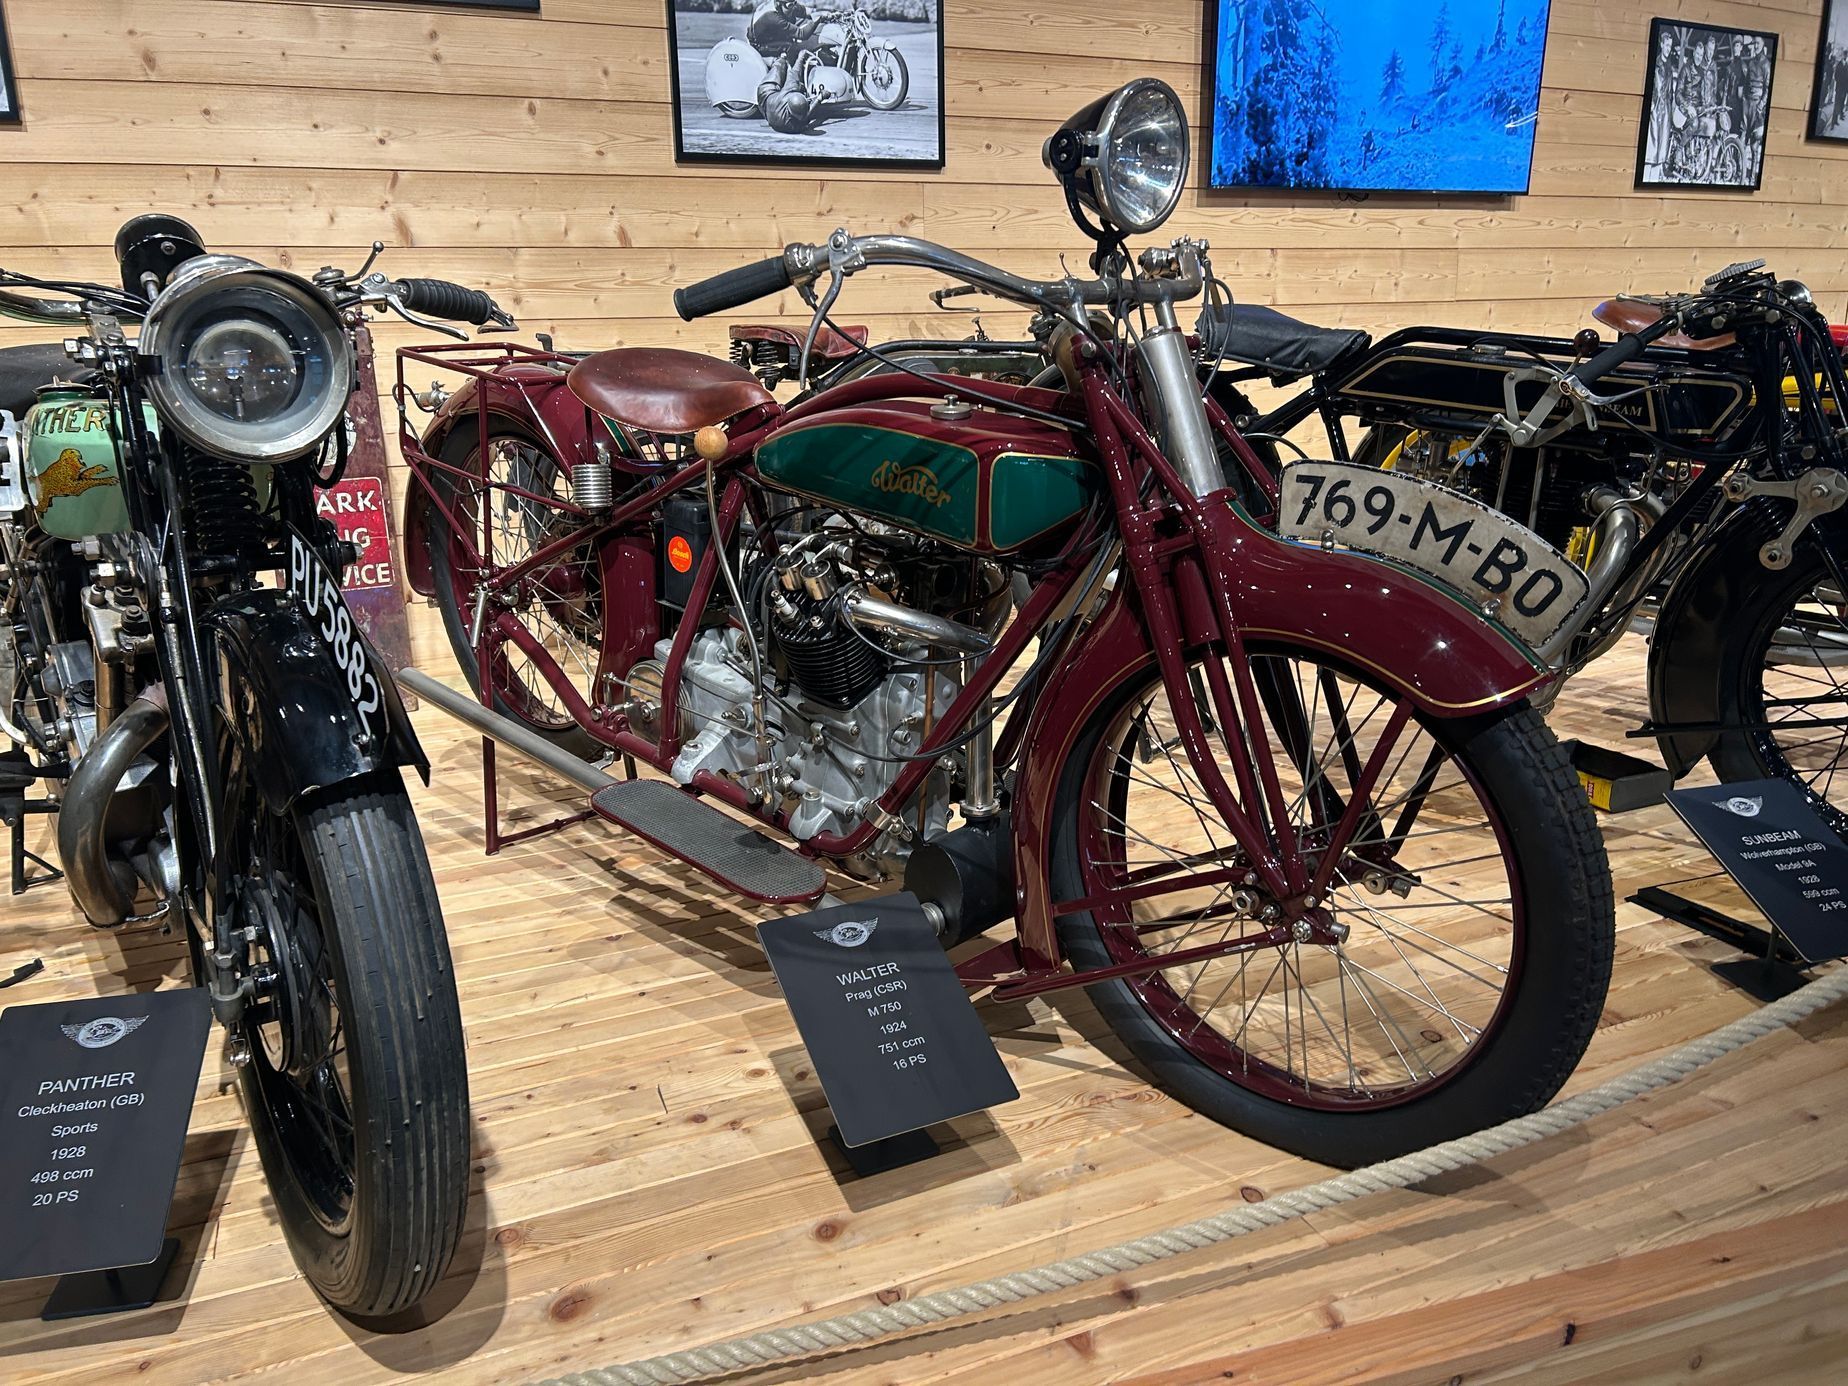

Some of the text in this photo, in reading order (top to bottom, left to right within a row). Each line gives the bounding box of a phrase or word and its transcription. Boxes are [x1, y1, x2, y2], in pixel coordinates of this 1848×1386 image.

[871, 460, 952, 508] Walter
[316, 490, 378, 515] ARK
[1741, 830, 1802, 846] SUNBEAM
[1740, 846, 1805, 860] Wolverhampton
[1775, 861, 1803, 871] Model
[1820, 888, 1840, 897] ccm
[1819, 900, 1847, 912] 24 PS
[836, 962, 900, 986] WALTER
[845, 980, 907, 1002] Prag (CSR)
[867, 1001, 902, 1018] M 750
[880, 1020, 907, 1035] 1924
[878, 1035, 926, 1055] 751 ccm
[892, 1053, 927, 1070] 16 PS
[38, 1071, 136, 1095] PANTHER
[18, 1093, 145, 1118] Cleckheaton (GB)
[51, 1122, 98, 1138] Sports
[50, 1145, 86, 1160] 1928
[31, 1167, 94, 1184] 498 ccm
[32, 1189, 79, 1206] 20 PS
